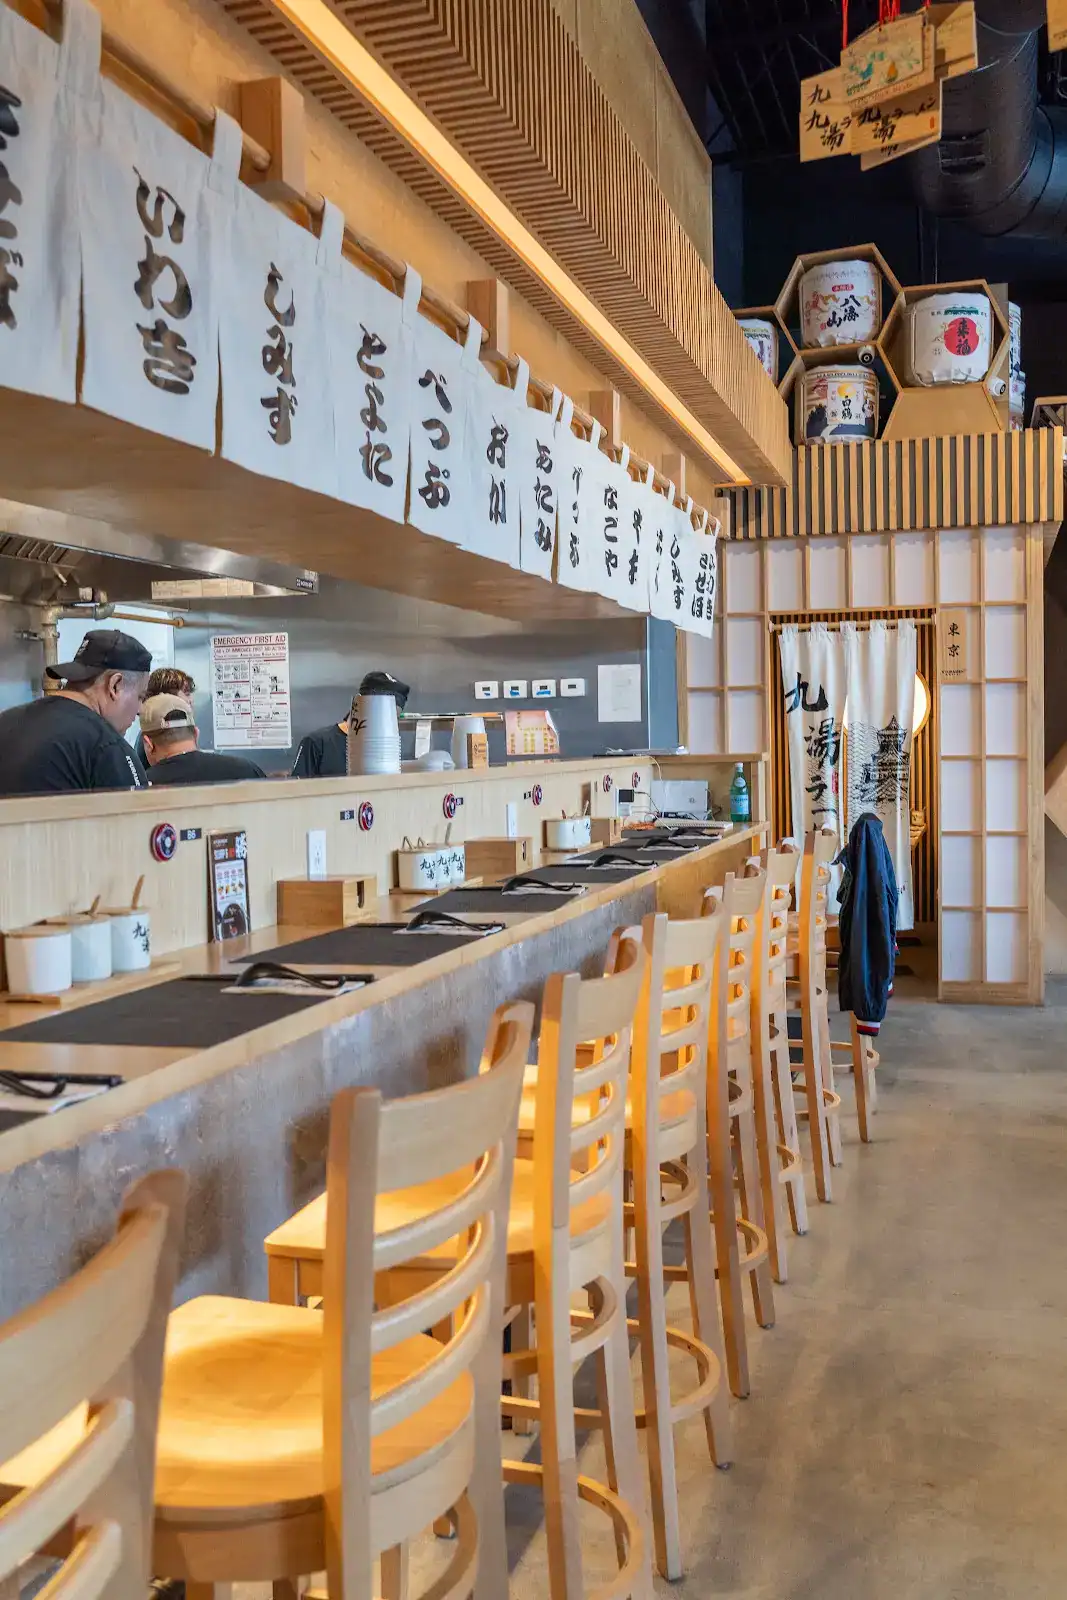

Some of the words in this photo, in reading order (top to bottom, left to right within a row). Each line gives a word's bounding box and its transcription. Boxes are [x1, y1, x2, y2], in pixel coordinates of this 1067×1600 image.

[533, 438, 554, 553] あたみ
[603, 484, 619, 578] なごや
[213, 637, 253, 645] EMERGENCY
[254, 636, 272, 644] FIRST
[275, 635, 286, 643] AID
[947, 622, 960, 658] 東京
